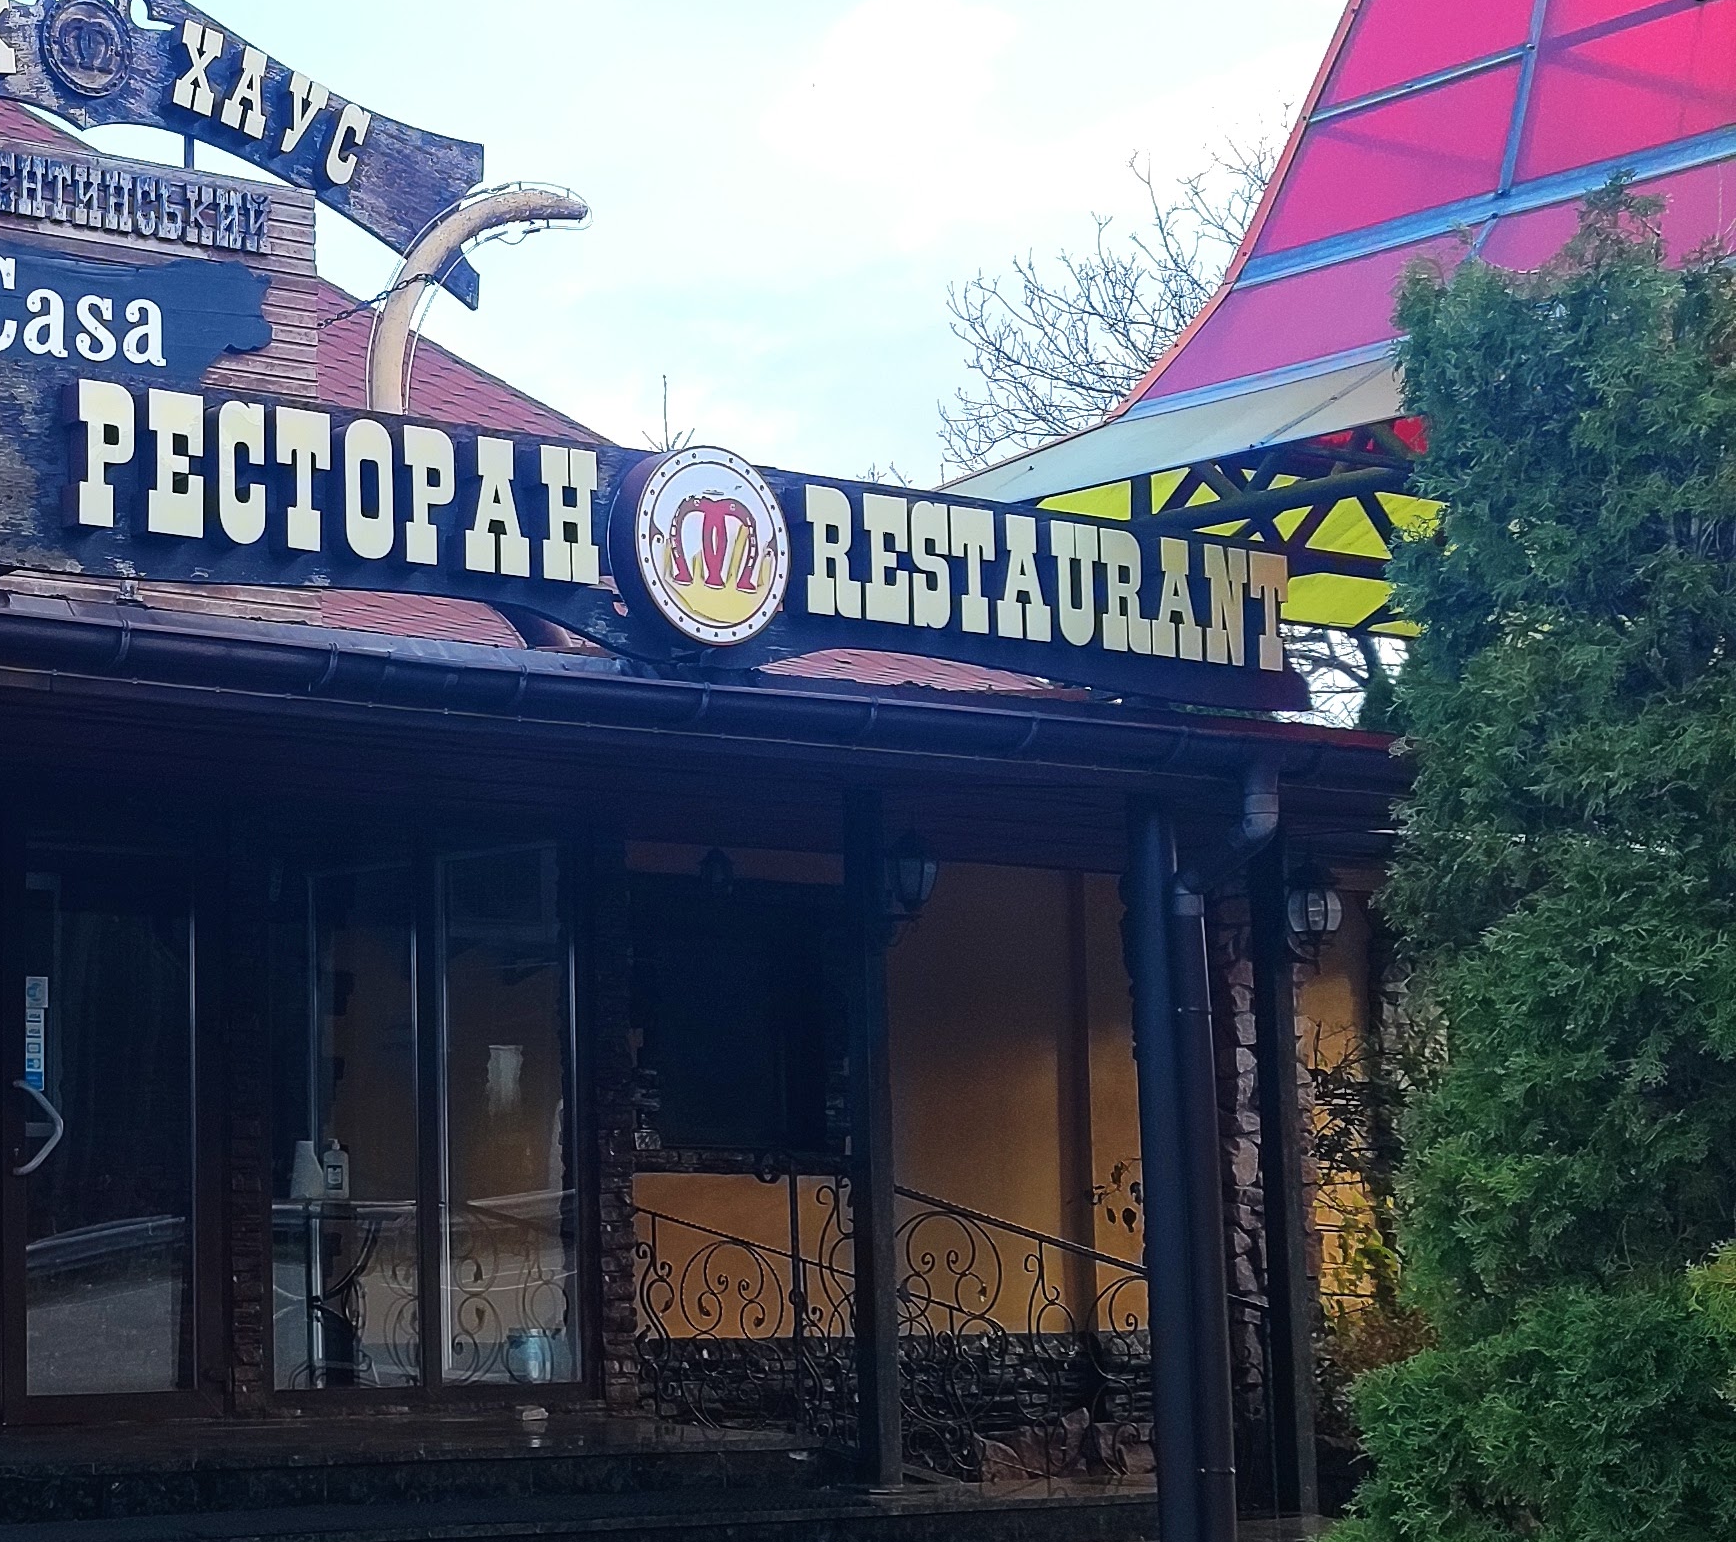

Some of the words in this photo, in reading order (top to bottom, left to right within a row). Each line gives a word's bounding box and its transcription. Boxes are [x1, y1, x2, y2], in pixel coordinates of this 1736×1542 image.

[173, 19, 371, 187] ХАУС
[77, 380, 599, 584] РЕСТОРАН
[805, 484, 1289, 672] RESTAURANT
